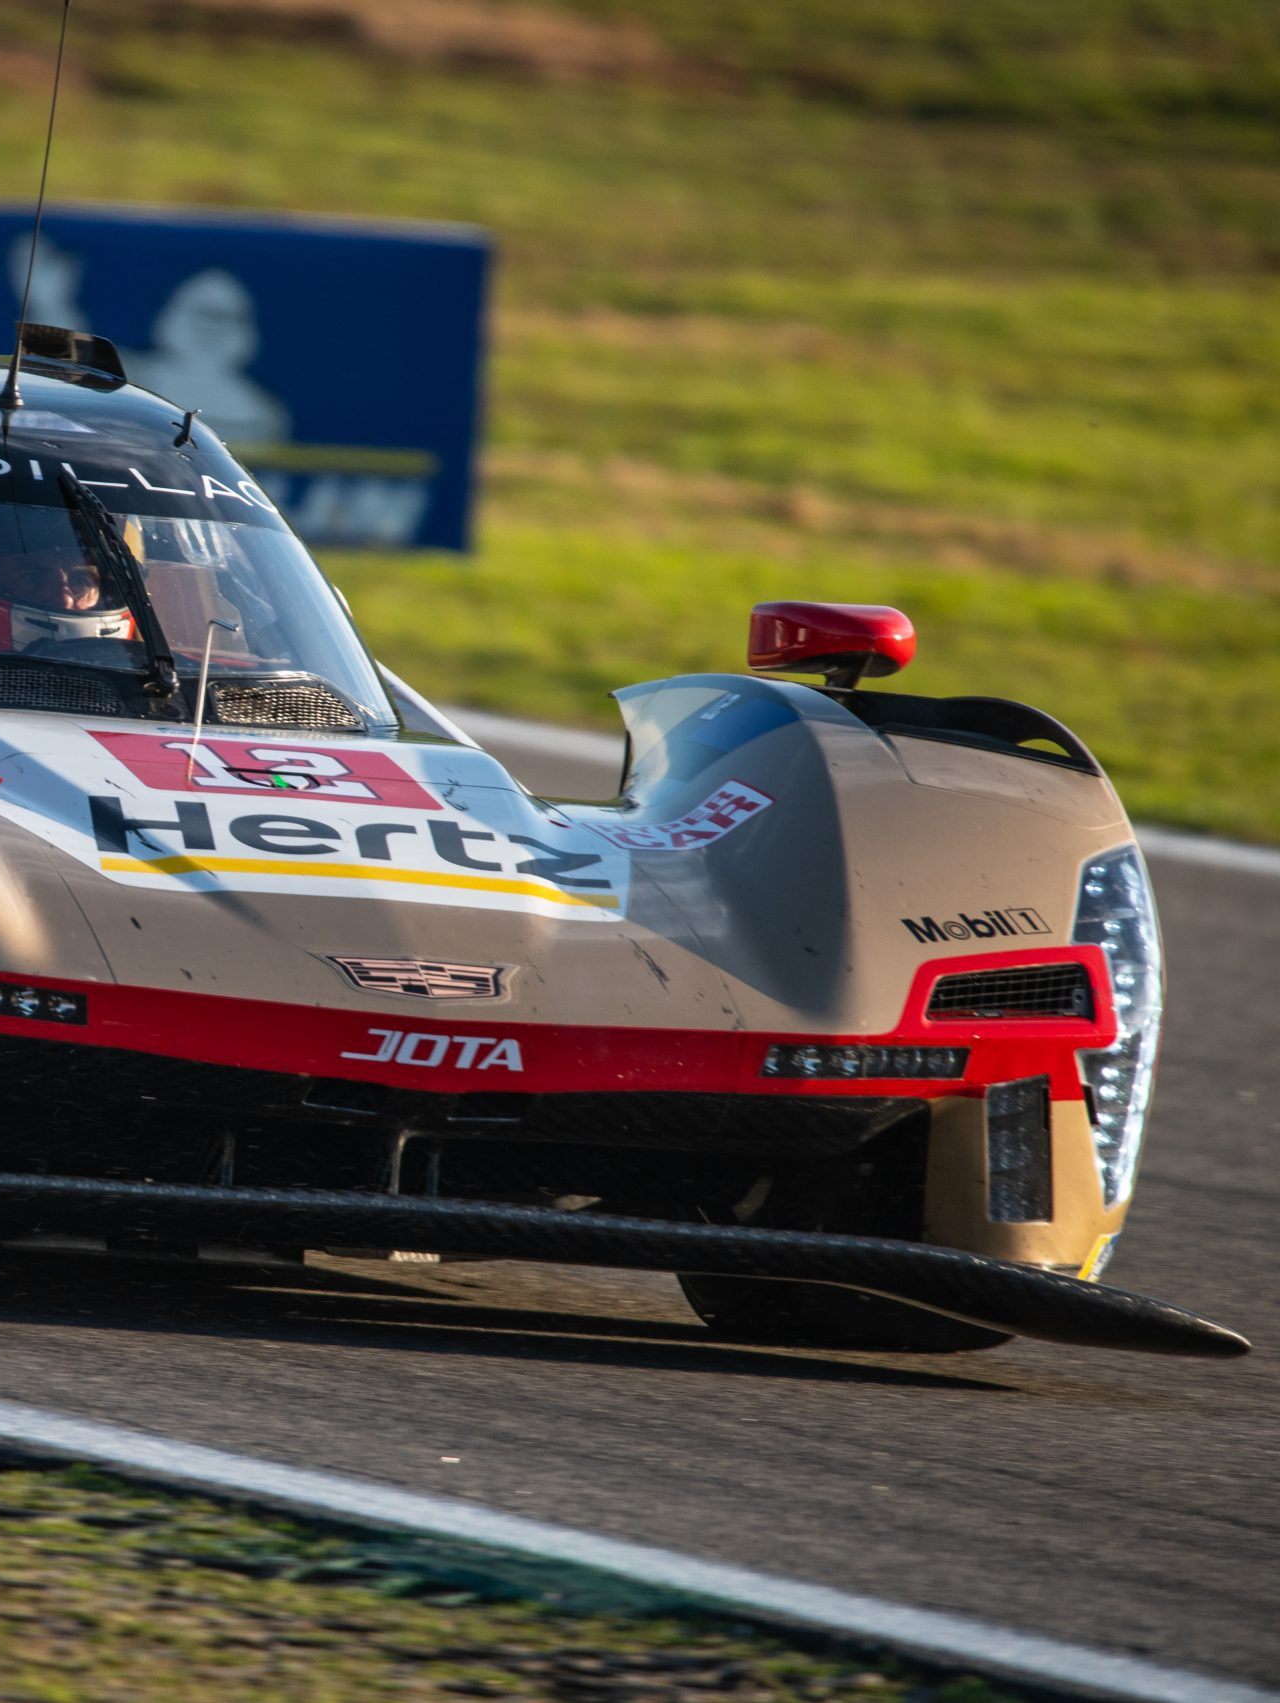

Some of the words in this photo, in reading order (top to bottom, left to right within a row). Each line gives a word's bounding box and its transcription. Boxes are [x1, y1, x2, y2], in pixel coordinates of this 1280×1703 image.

[160, 741, 381, 800] 12
[594, 789, 735, 836] HYPER
[613, 796, 763, 848] CAR
[88, 795, 612, 890] Hertz
[899, 910, 1019, 944] Mobil
[339, 1028, 524, 1072] JOTA
